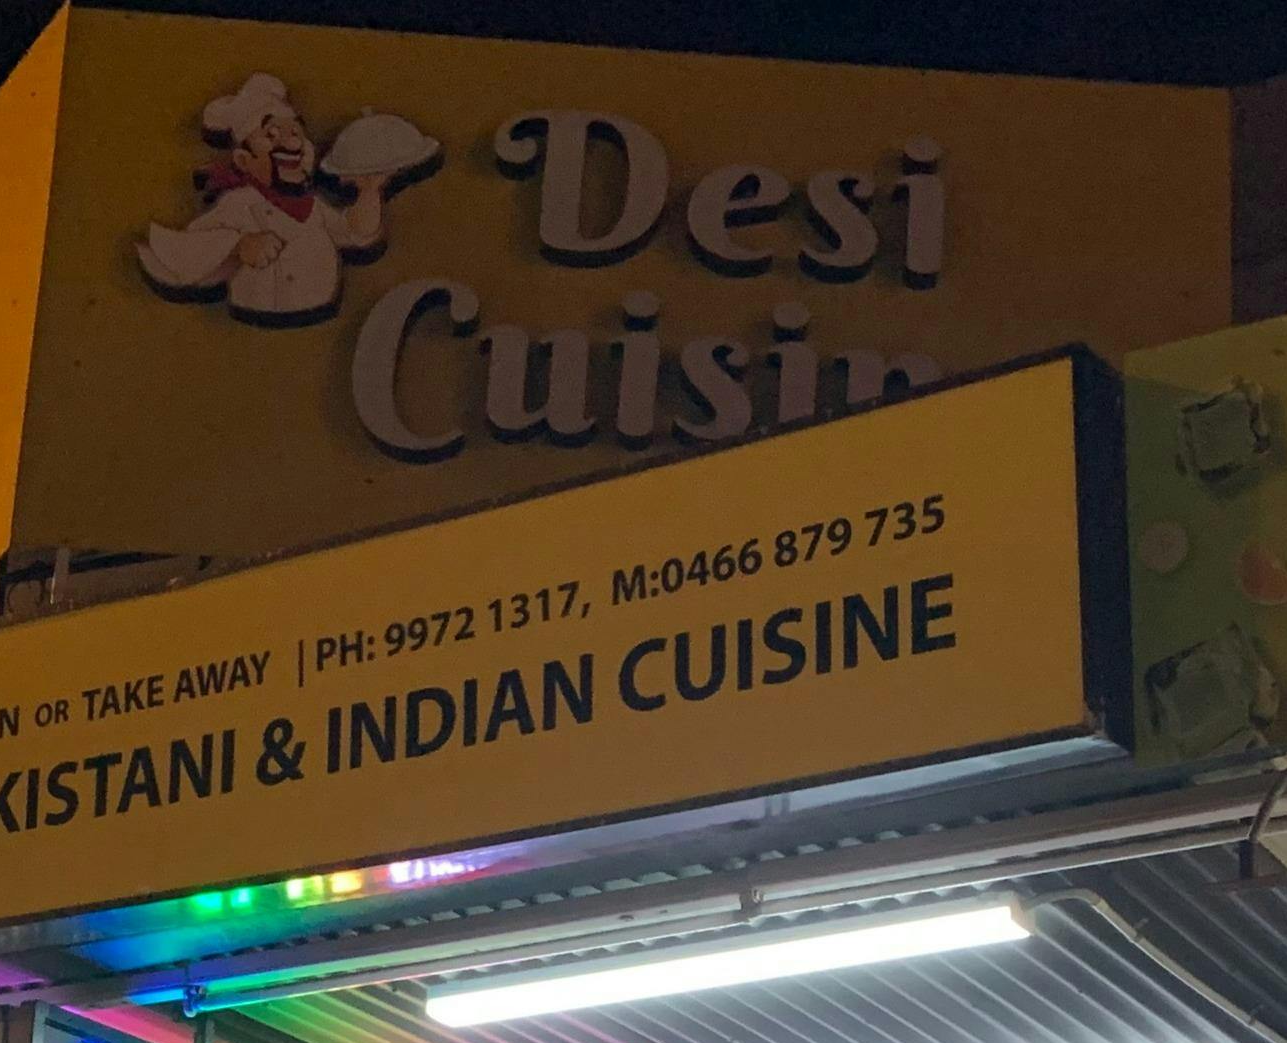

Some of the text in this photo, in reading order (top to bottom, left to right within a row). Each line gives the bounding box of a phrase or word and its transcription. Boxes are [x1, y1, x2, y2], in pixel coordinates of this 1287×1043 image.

[494, 108, 945, 282] Desi
[352, 276, 944, 455] Cuisin
[34, 699, 70, 728] OR
[81, 674, 165, 721] TAKE
[173, 649, 271, 704] AWAY
[316, 628, 376, 672] PH:
[384, 606, 476, 657] 9972
[488, 580, 591, 635] 1317,
[611, 538, 763, 607] M:0466
[774, 518, 853, 569] 879
[863, 493, 947, 547] 735
[255, 717, 307, 787] &
[325, 652, 595, 776] INDIAN
[617, 572, 958, 712] CUISINE
